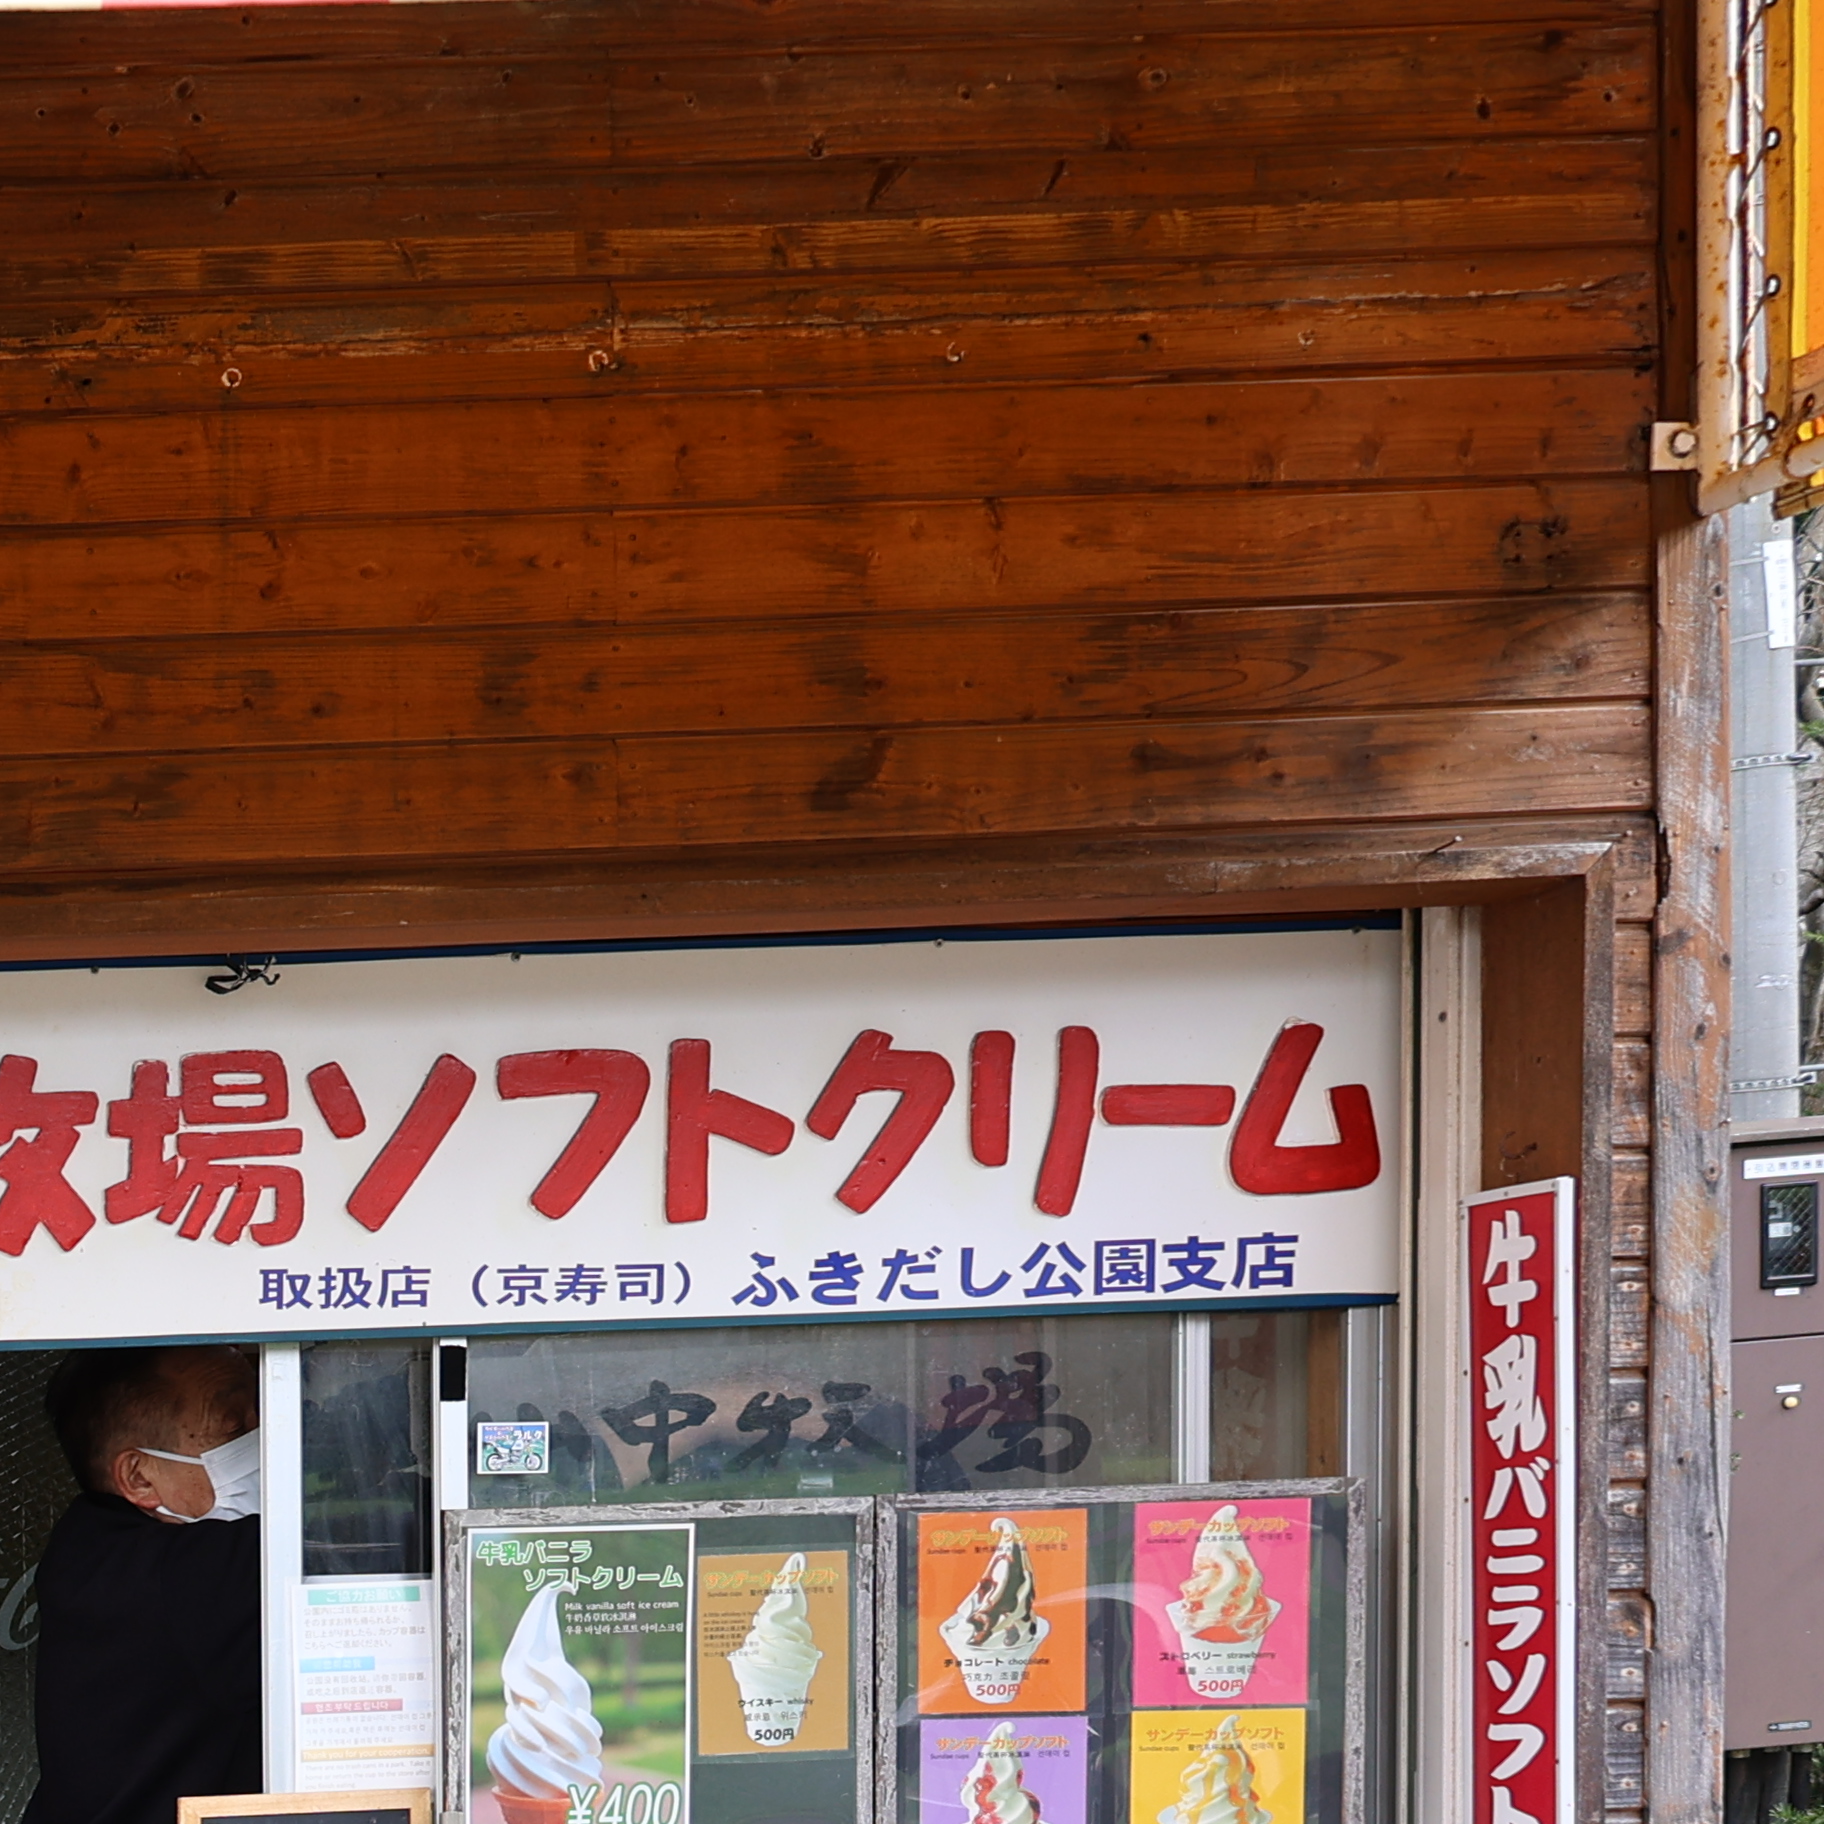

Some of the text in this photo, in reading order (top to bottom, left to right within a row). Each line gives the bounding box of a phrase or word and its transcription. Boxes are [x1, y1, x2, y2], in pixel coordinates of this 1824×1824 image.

[730, 1233, 1302, 1307] ふきだし公園支店
[475, 1537, 593, 1566] 牛乳バニラ
[524, 1563, 685, 1592] ソフトクリーム
[703, 1567, 840, 1588] サンデーカップソフト
[565, 1601, 680, 1611] Milk vanilla soft ice cream
[943, 1657, 1004, 1669] チョコレート
[1159, 1650, 1277, 1662] ストロベリー strawberry
[975, 1683, 1021, 1697] 500円
[1197, 1678, 1245, 1693] 500円
[737, 1697, 814, 1708] ウイスキー whisky
[754, 1727, 795, 1742] 500円
[1145, 1726, 1286, 1743] サンデーカップソフト
[935, 1734, 1071, 1751] サンデーカップソフト
